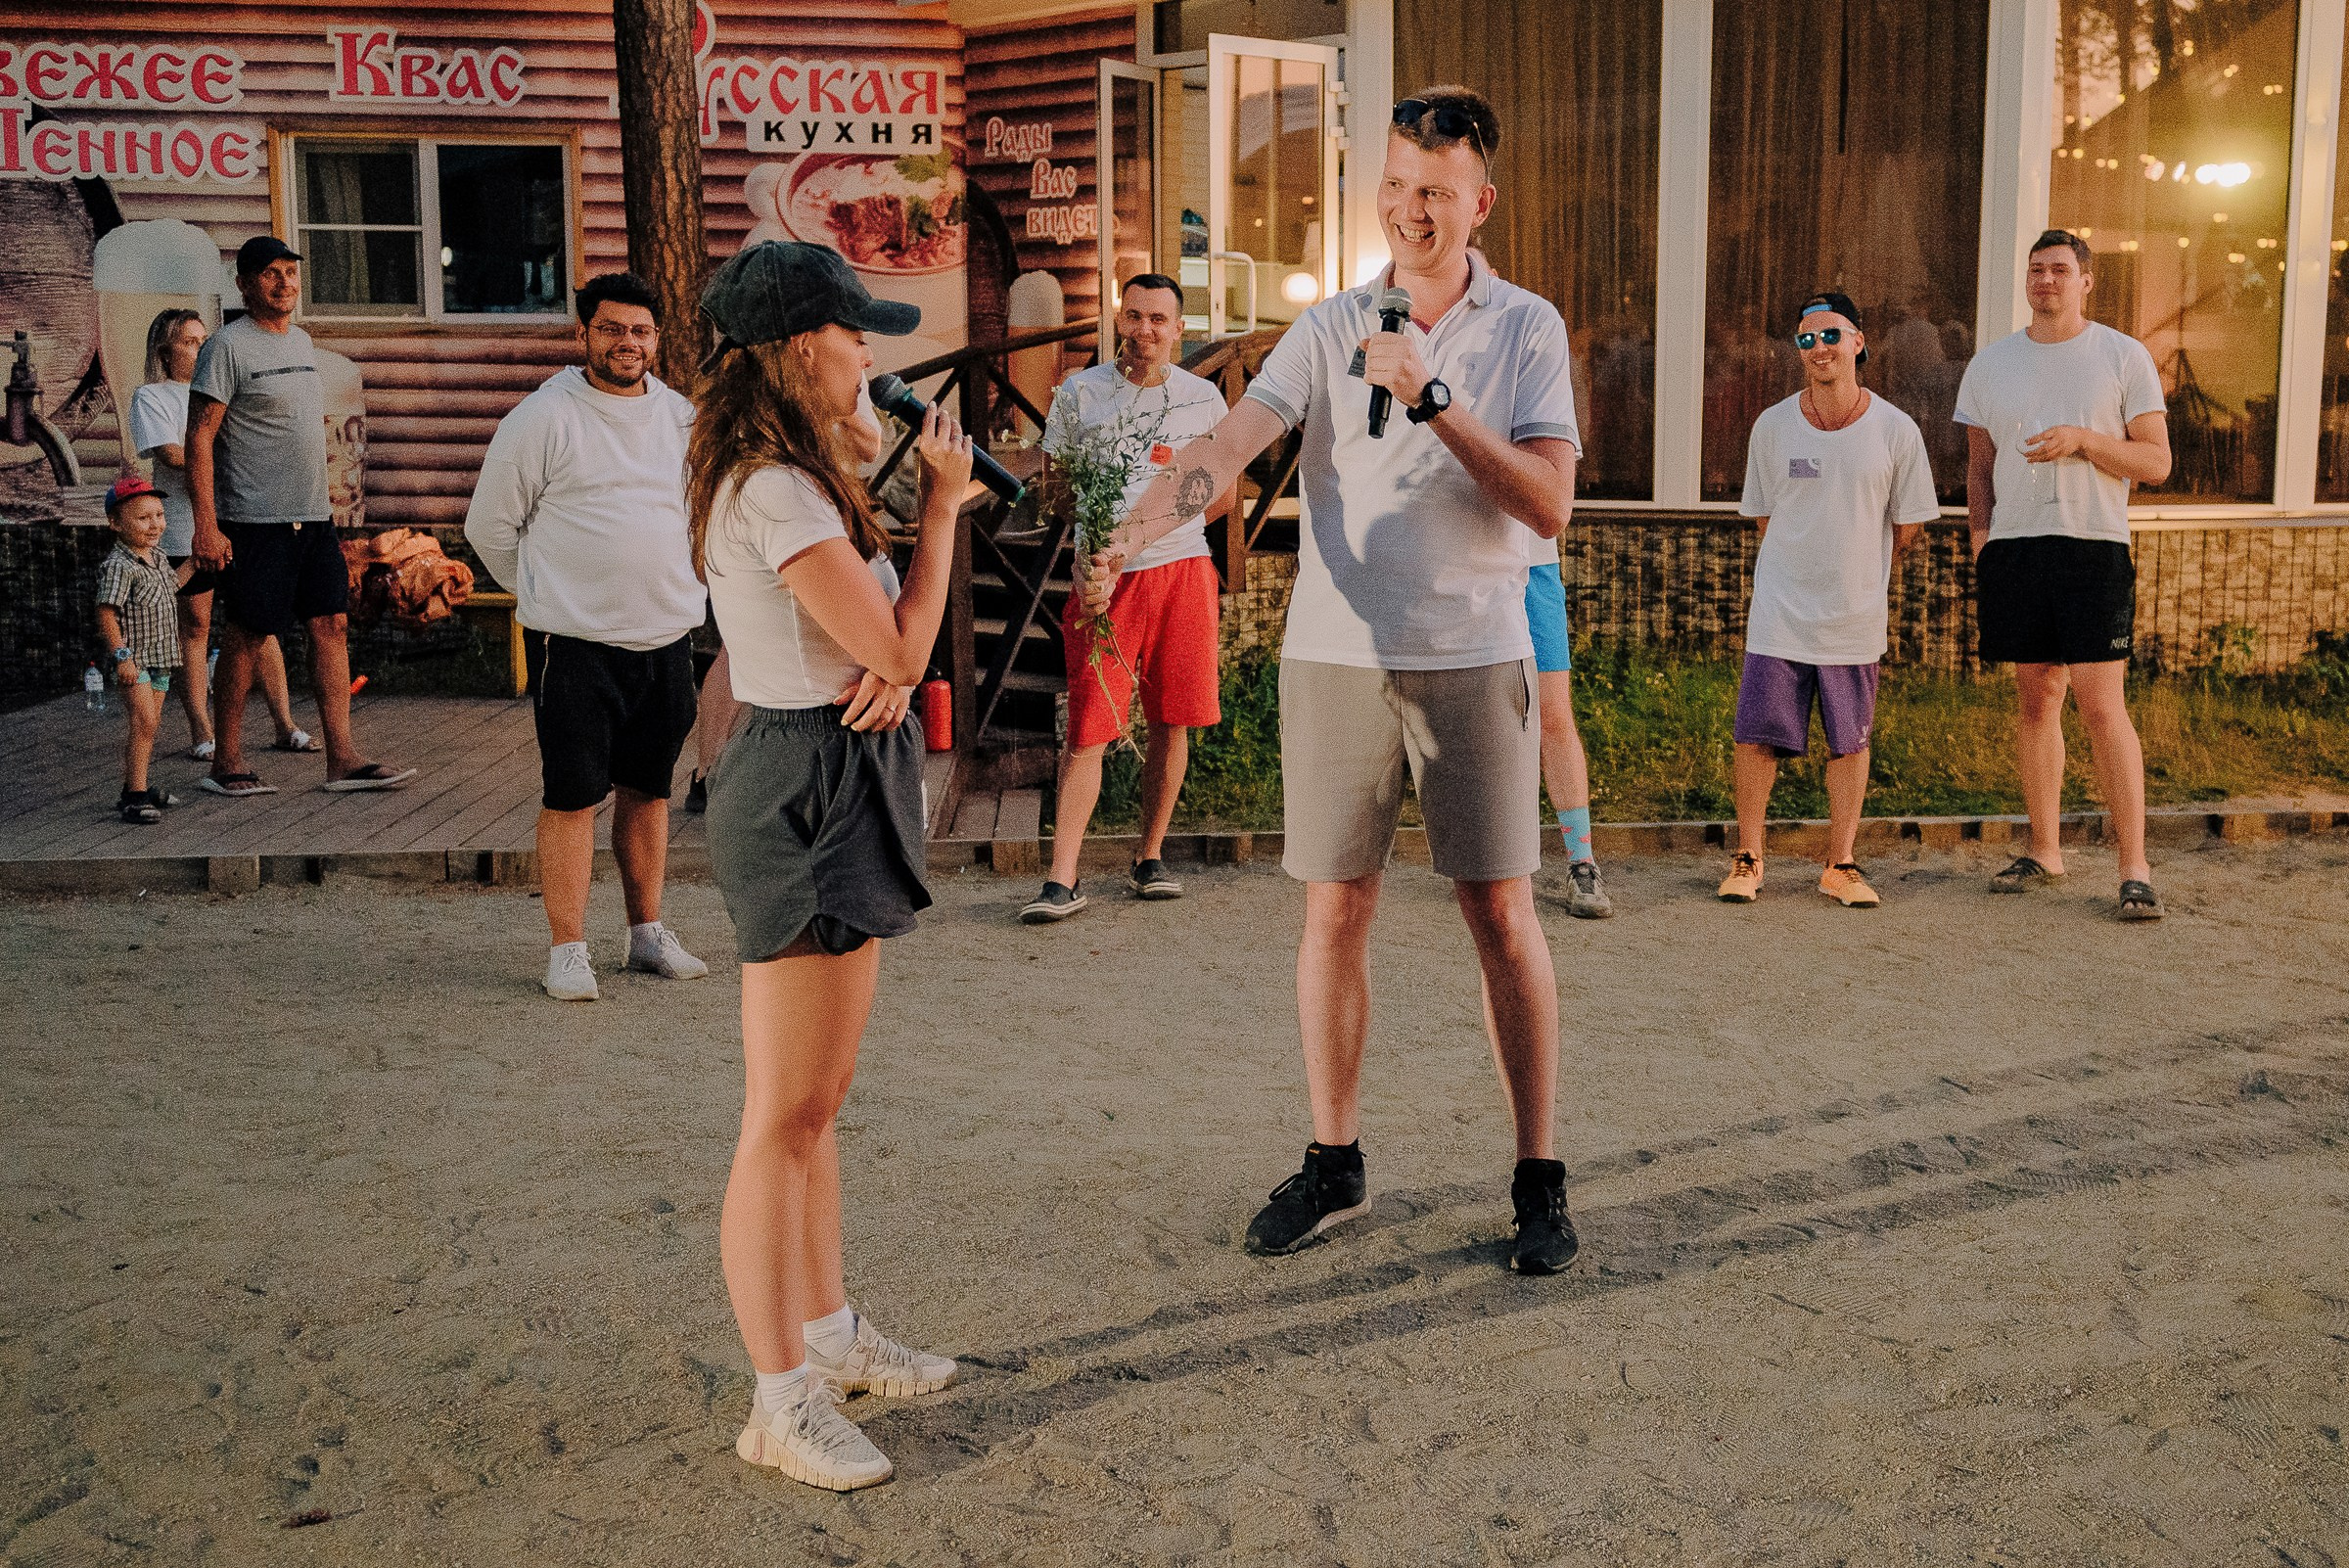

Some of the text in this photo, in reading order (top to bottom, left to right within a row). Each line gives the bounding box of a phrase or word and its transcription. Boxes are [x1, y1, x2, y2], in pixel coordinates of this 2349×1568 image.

[335, 31, 522, 103] Квас
[693, 4, 940, 136] усская
[763, 119, 934, 150] кухня
[985, 116, 1052, 162] Рады
[1031, 158, 1077, 199] Вас
